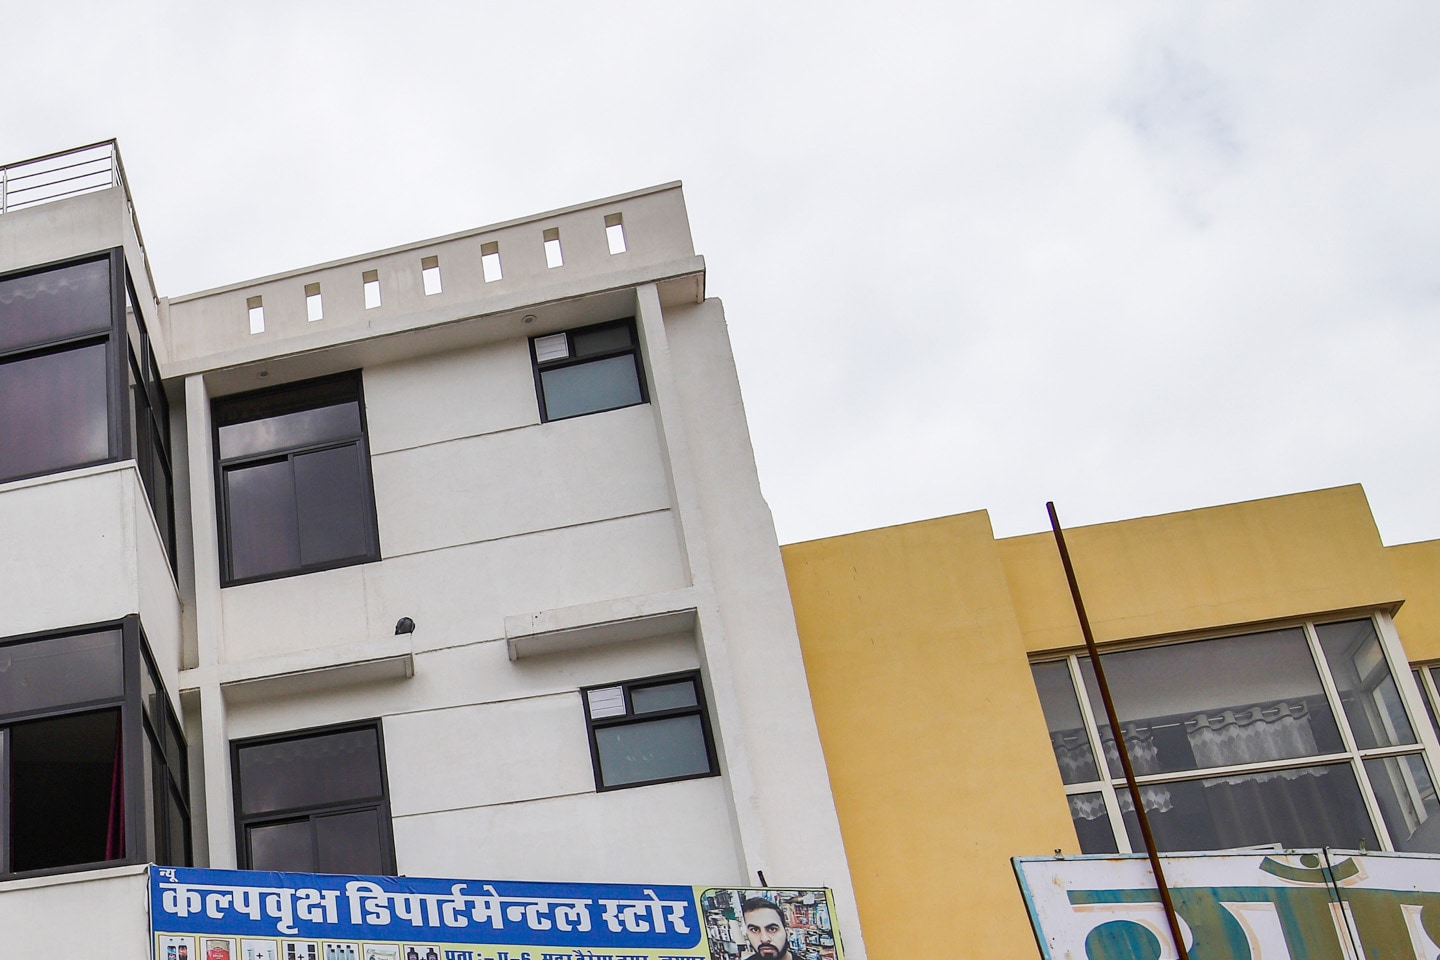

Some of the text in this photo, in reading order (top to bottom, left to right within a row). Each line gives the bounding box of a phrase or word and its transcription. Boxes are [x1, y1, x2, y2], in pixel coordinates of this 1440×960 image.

[159, 868, 178, 882] न्यू
[159, 881, 691, 935] कल्पवृक्ष डिपार्टमेन्टल स्टोर
